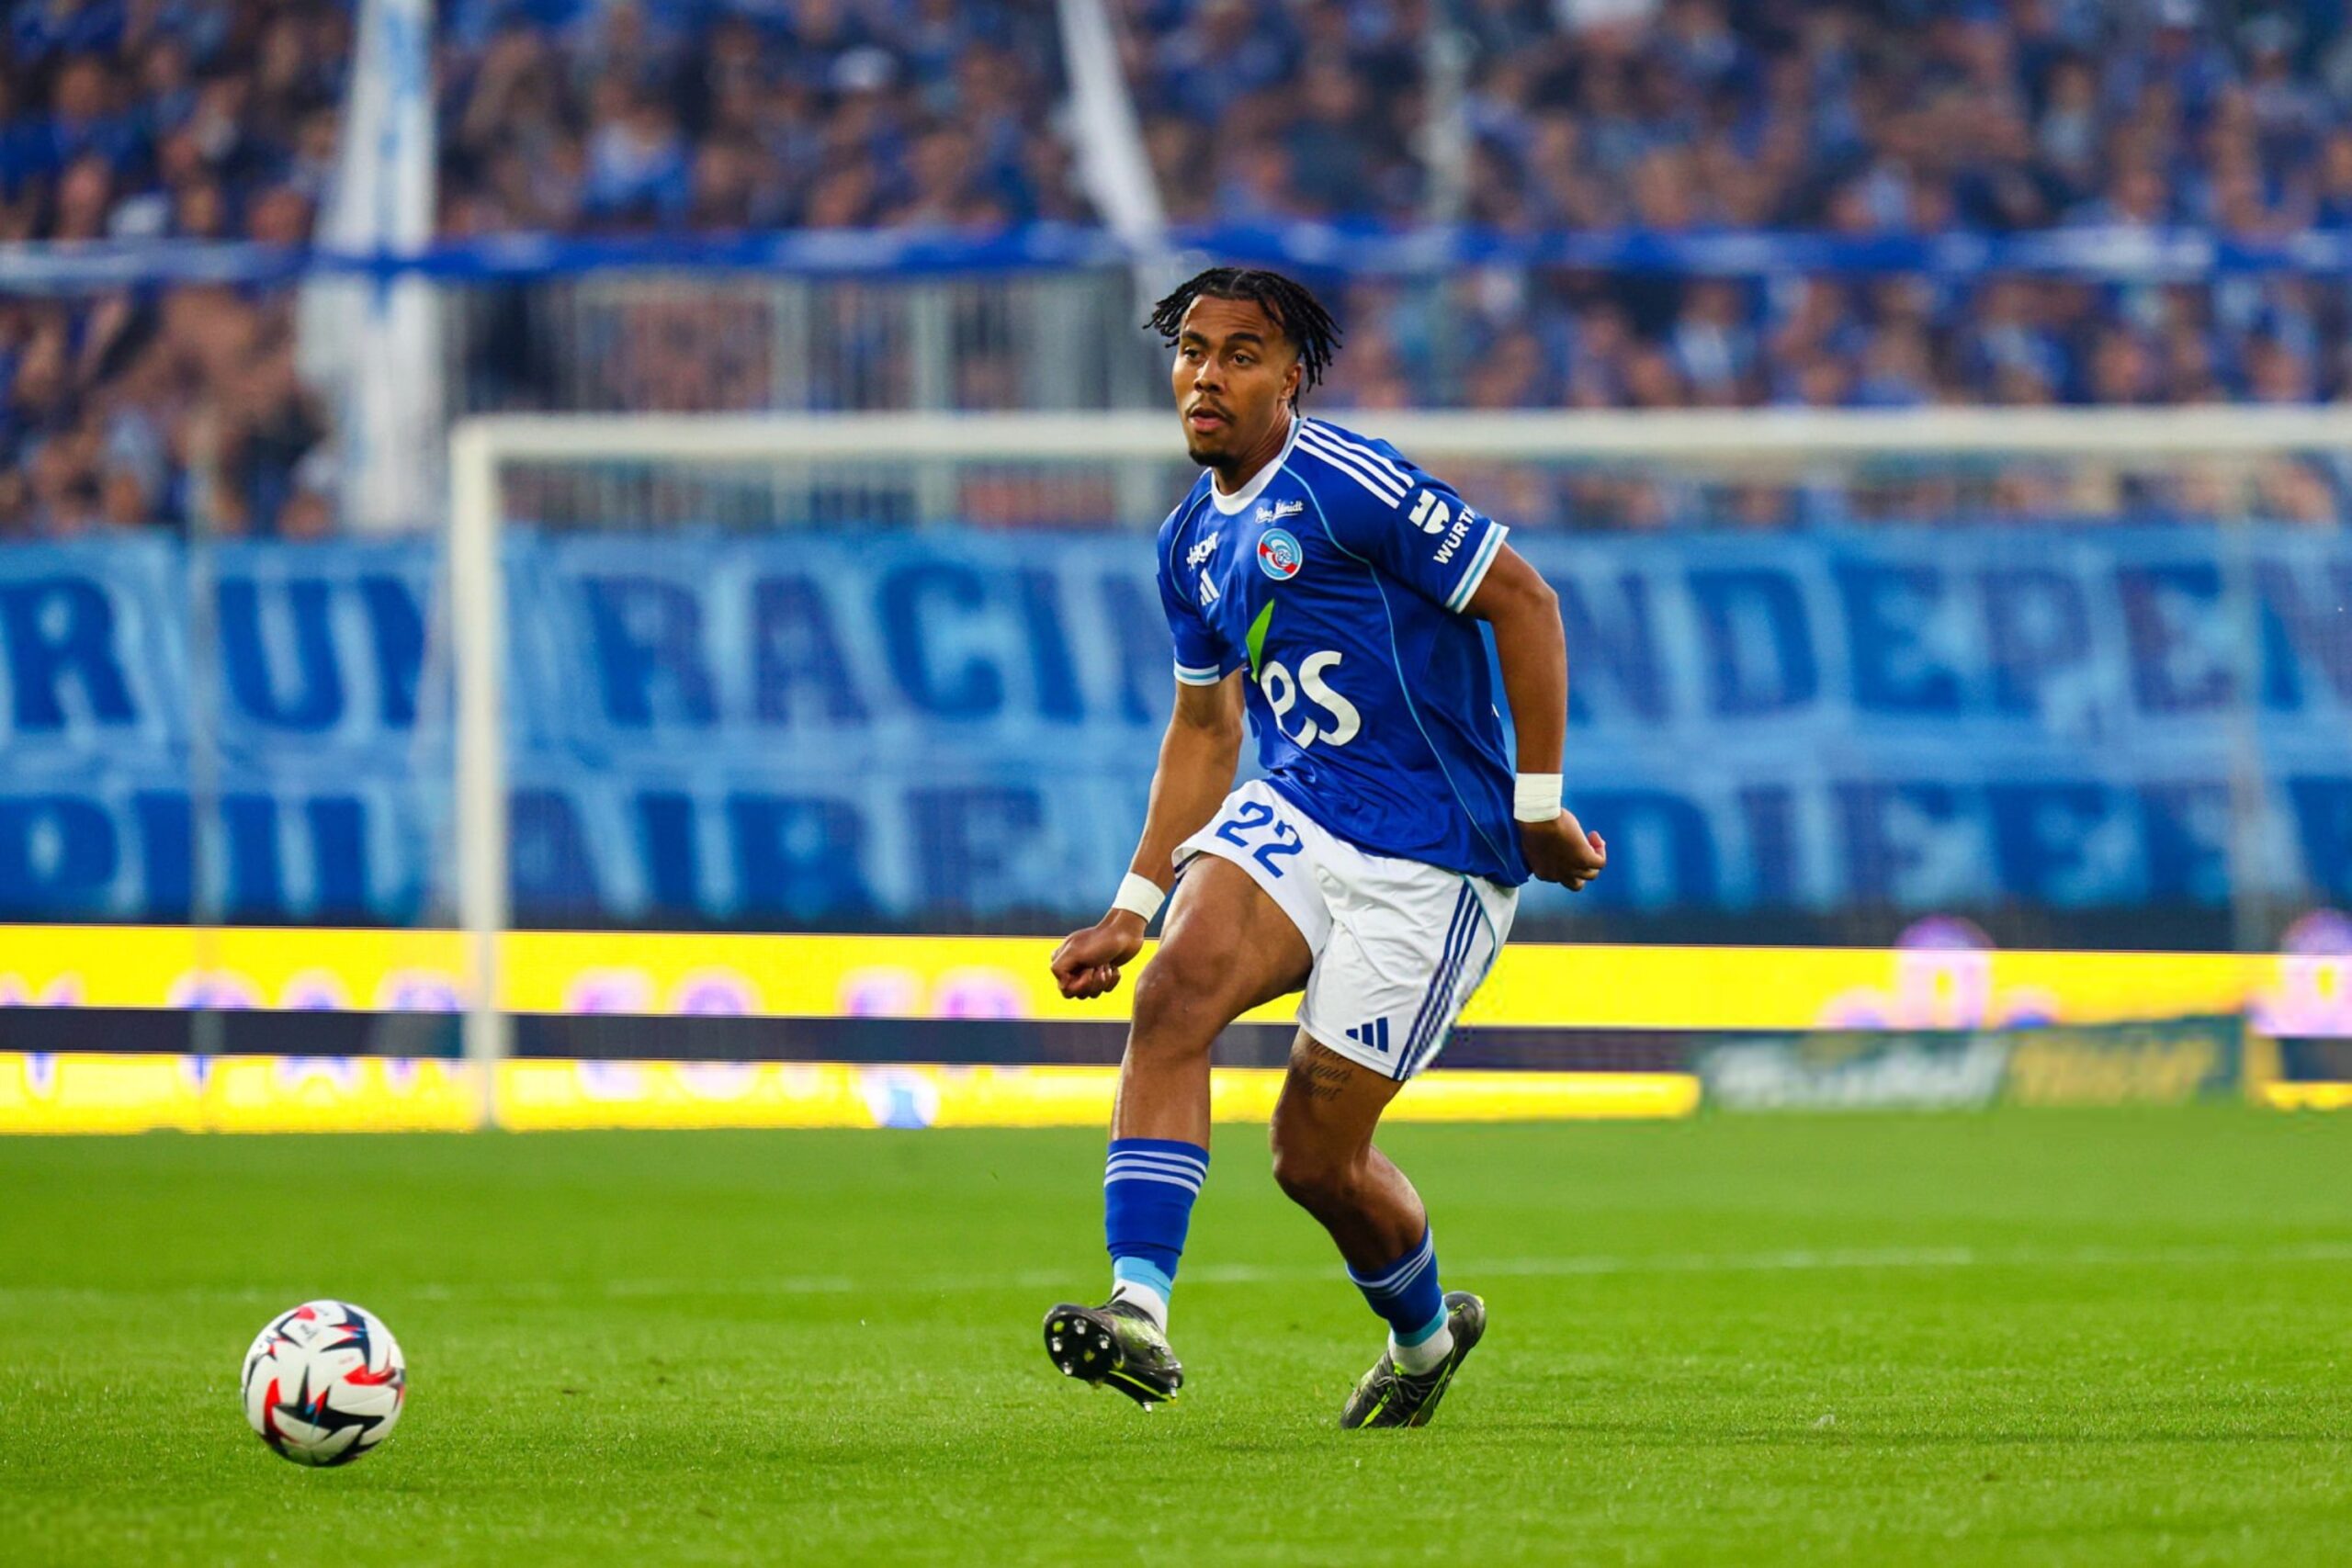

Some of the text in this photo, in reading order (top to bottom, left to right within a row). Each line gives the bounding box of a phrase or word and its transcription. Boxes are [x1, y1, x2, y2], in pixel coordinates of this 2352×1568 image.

[581, 565, 1156, 726] RACIN
[1553, 562, 2352, 718] NDEPEN
[1216, 801, 1304, 878] 22
